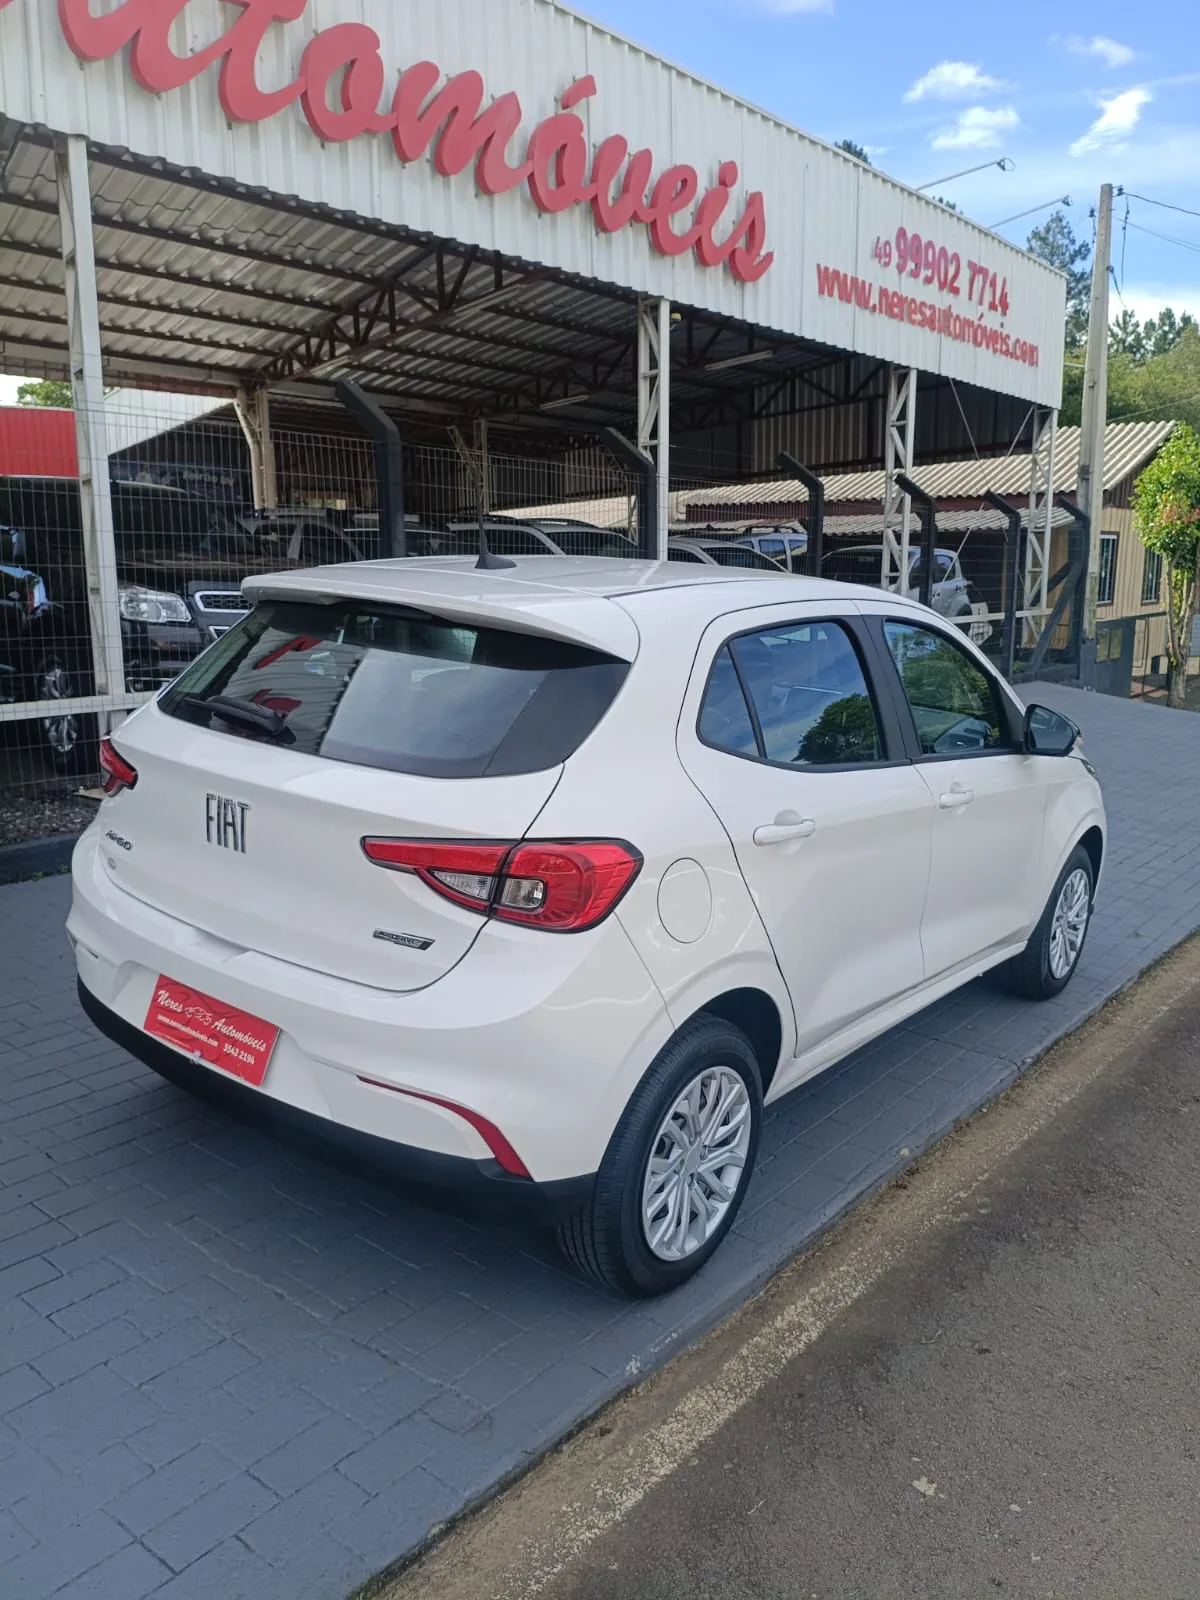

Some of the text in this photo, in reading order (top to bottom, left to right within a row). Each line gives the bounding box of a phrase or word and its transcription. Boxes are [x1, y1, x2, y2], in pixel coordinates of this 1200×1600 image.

[0, 0, 774, 283] tomóveis
[816, 263, 1039, 368] www.neresautomóveis.com
[874, 226, 1009, 317] 49 99902 7714
[205, 793, 250, 854] FIAT
[211, 1017, 267, 1052] Automóveis
